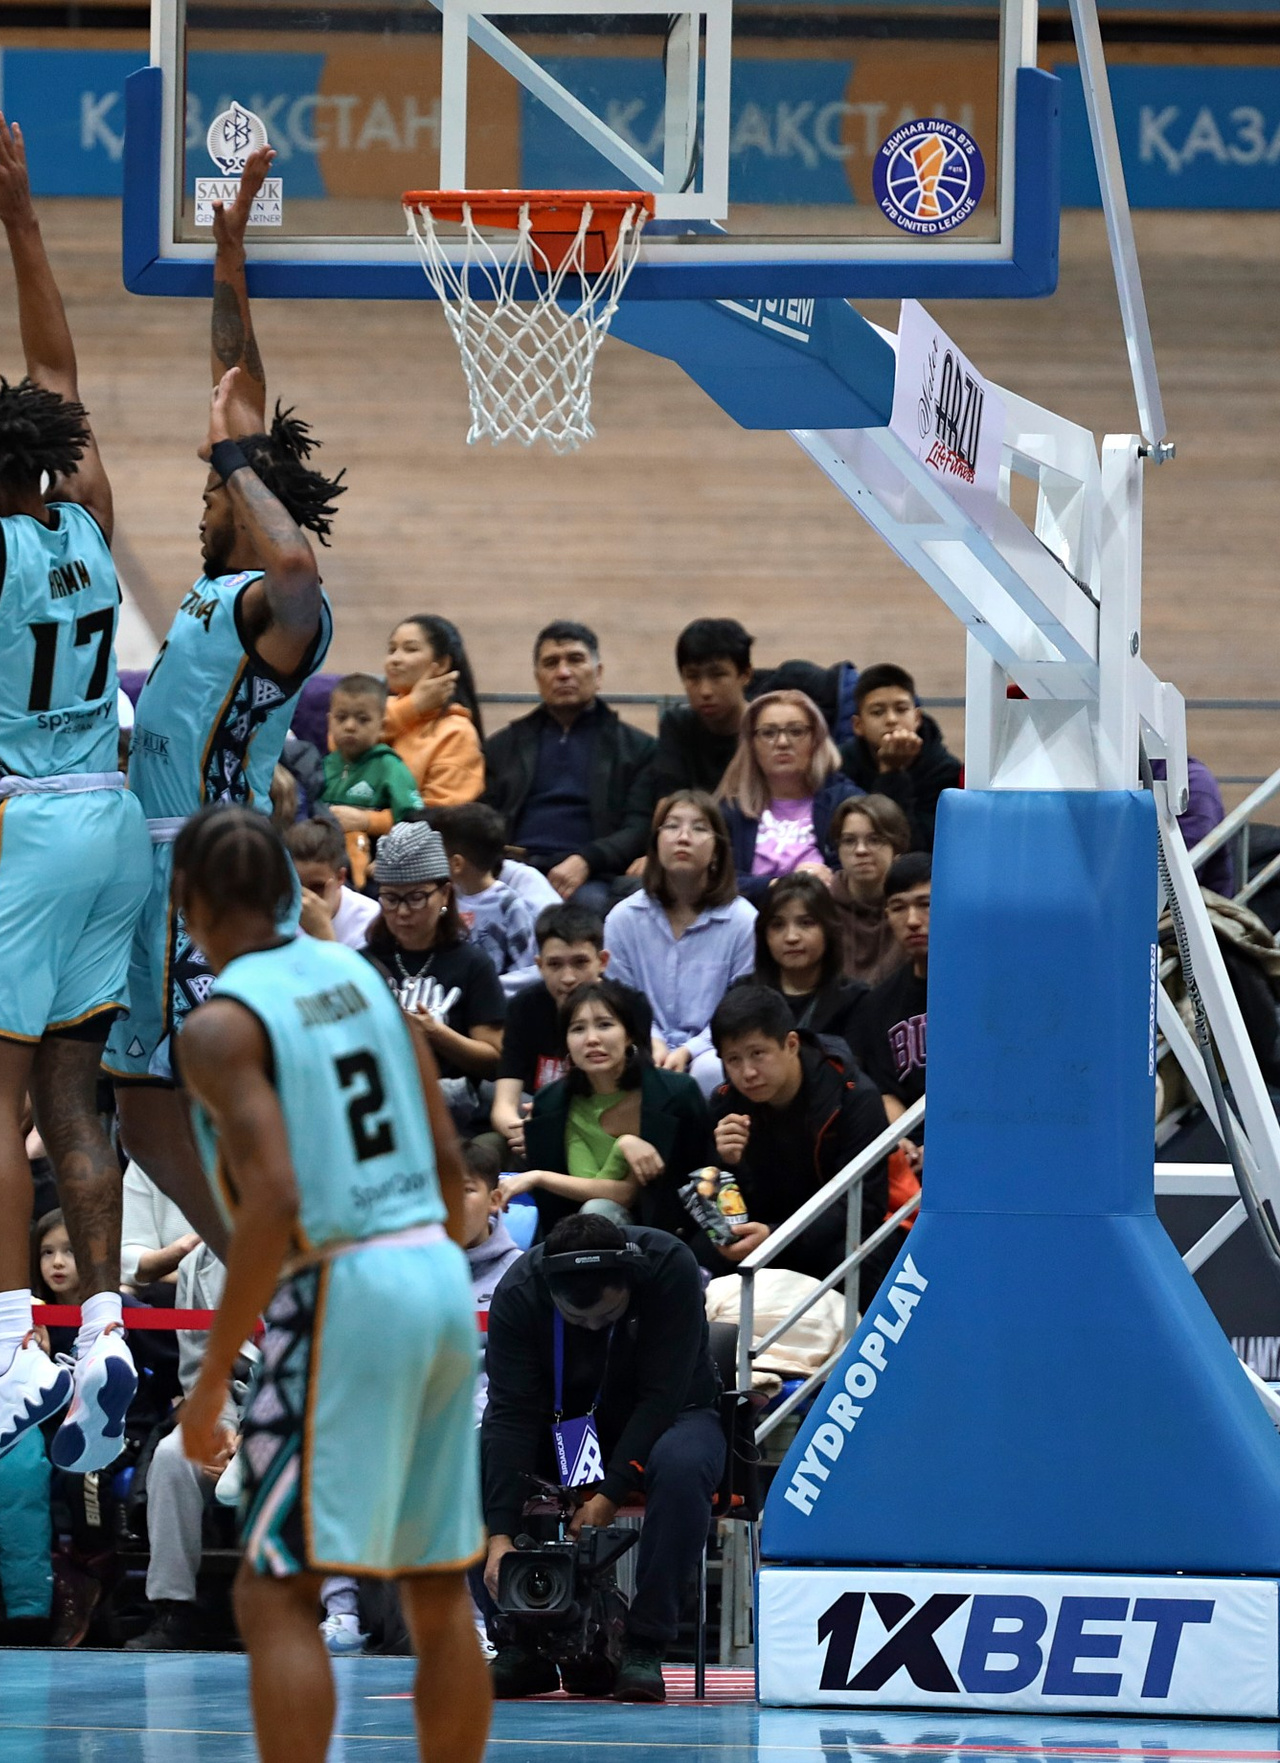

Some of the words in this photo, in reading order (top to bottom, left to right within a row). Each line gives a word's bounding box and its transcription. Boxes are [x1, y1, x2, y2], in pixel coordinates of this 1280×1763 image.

[882, 122, 925, 156] ЕДИНАЯ
[927, 121, 957, 138] ЛИГА
[957, 133, 976, 155] ВТБ
[198, 183, 279, 199] SAMUK
[248, 214, 281, 223] ARTNER
[881, 197, 898, 219] VTB
[897, 215, 937, 233] UNITED
[939, 197, 976, 231] LEAGUE
[28, 606, 115, 712] 17
[333, 1047, 396, 1163] 2
[784, 1252, 931, 1517] HYDROPLAY
[555, 1432, 569, 1476] BROADCAST
[817, 1591, 1216, 1699] 1XBET
